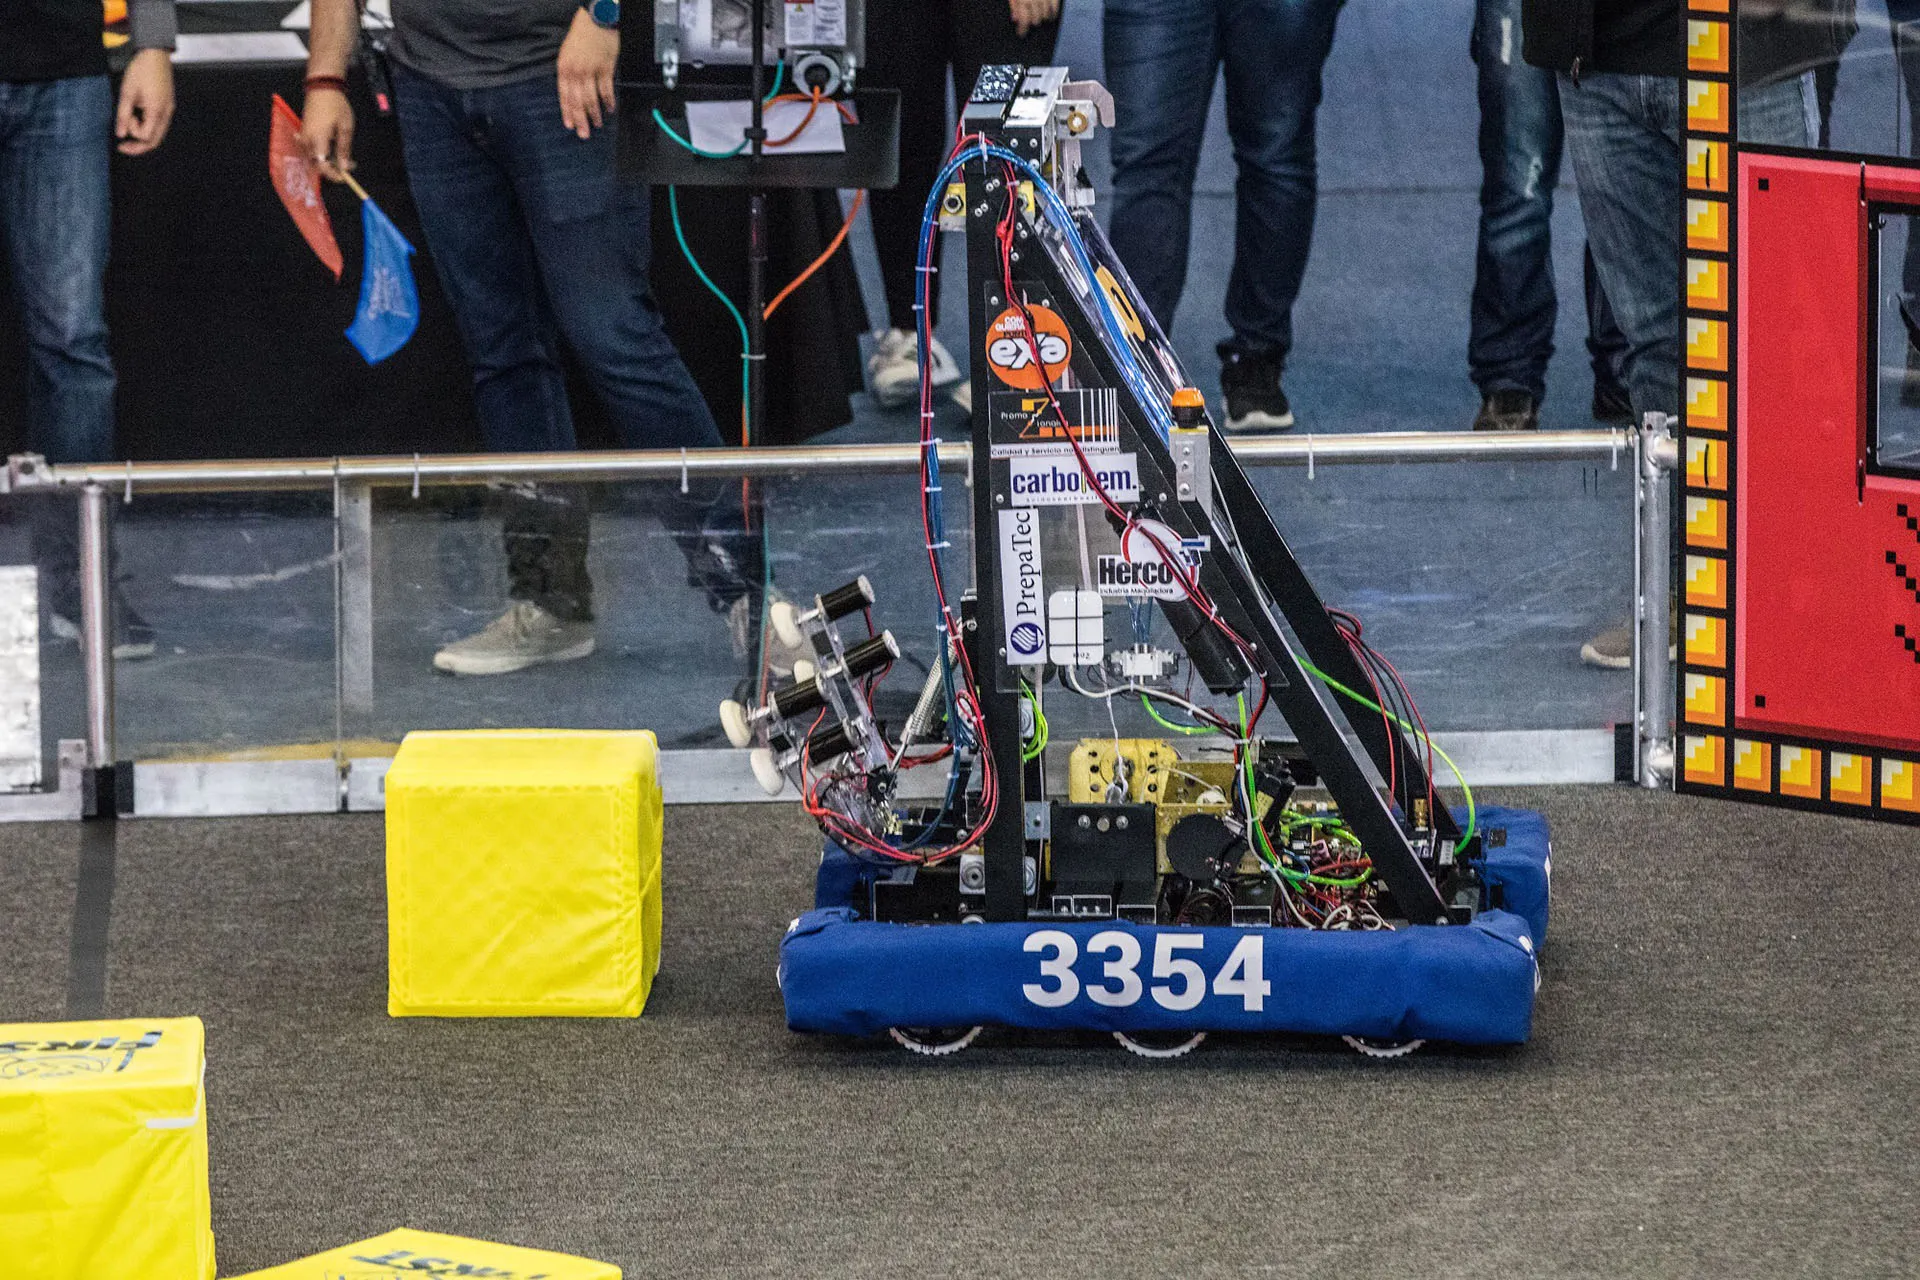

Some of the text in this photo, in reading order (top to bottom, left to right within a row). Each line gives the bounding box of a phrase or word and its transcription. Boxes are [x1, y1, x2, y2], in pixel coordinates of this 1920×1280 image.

[1001, 412, 1028, 420] Promo
[991, 448, 1023, 456] Calidad
[1031, 447, 1062, 455] Servicio
[1012, 511, 1041, 616] PrepaTec
[1099, 558, 1174, 584] Herco
[1022, 929, 1272, 1012] 3354
